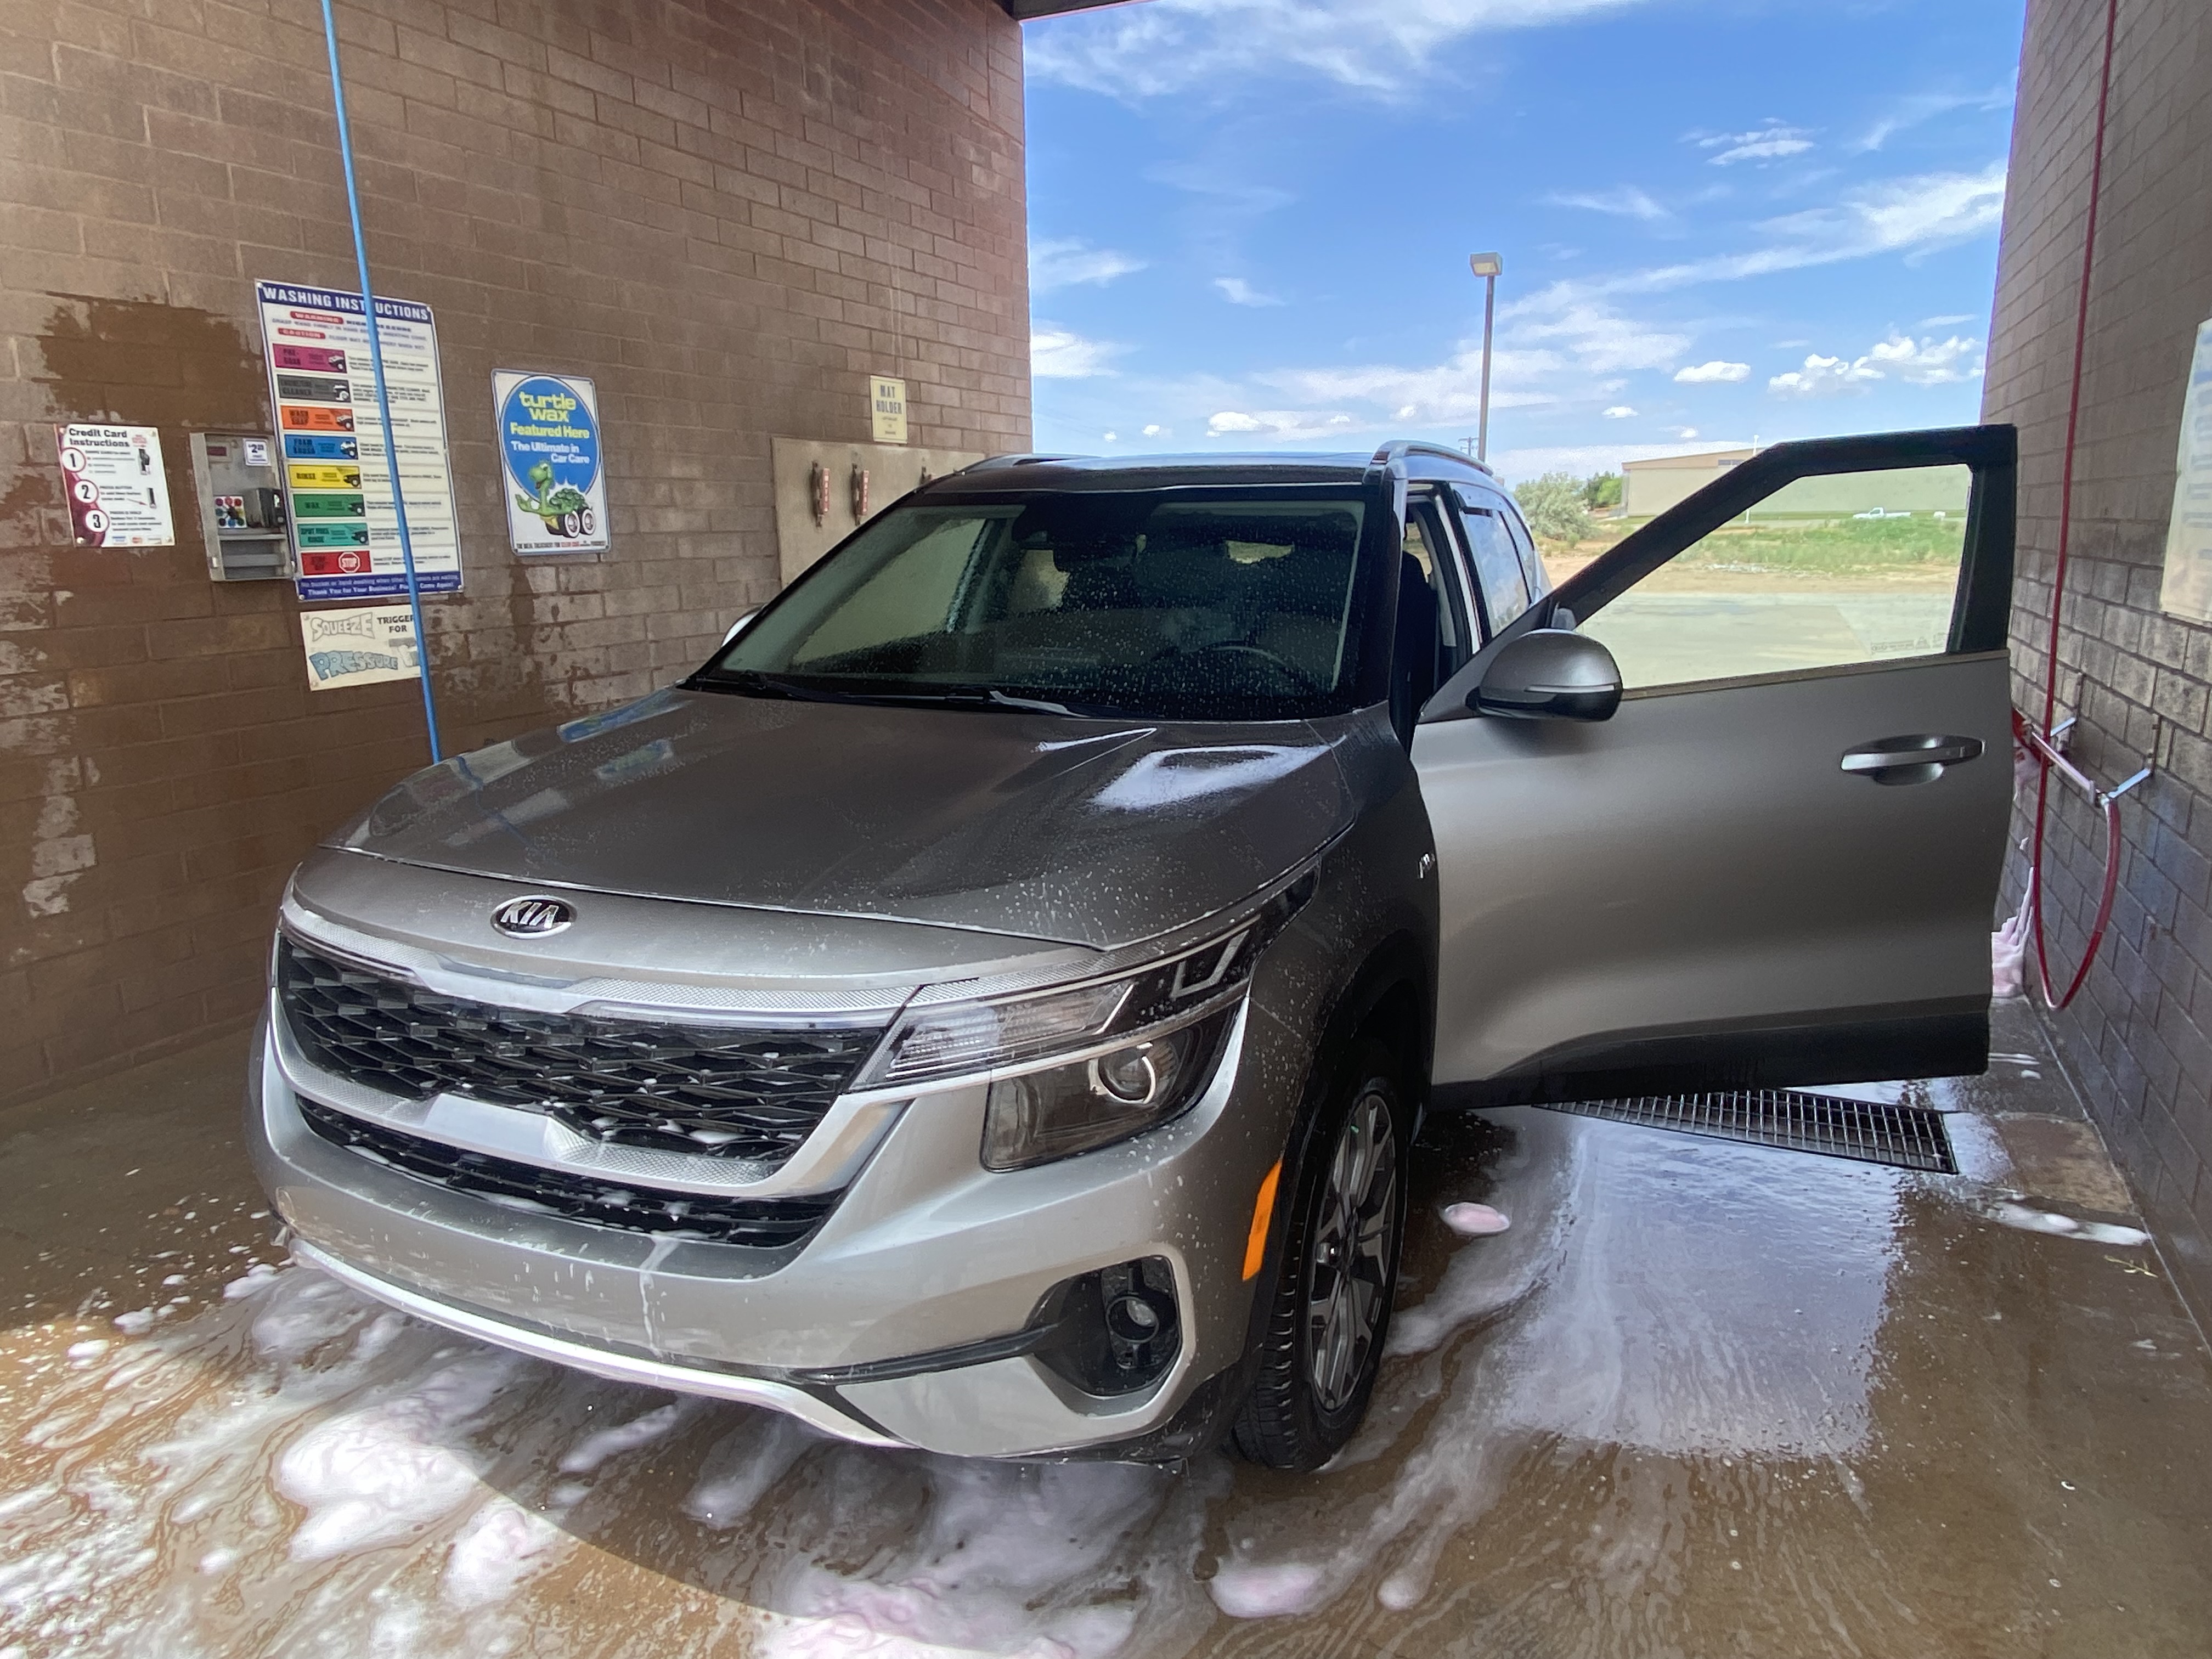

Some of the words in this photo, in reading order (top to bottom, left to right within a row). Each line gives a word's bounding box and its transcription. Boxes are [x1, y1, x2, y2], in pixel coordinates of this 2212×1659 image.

[263, 287, 332, 307] WASHING
[336, 297, 428, 320] INSTUCTIONS
[880, 385, 895, 398] MAT
[519, 391, 577, 411] turtle
[876, 399, 902, 415] HOLDER
[529, 408, 569, 422] wax
[69, 428, 101, 437] Credit
[104, 429, 127, 438] Card
[510, 422, 562, 438] Featured
[563, 426, 590, 439] Here
[69, 438, 129, 447] Instructions
[511, 440, 530, 452] The
[531, 441, 570, 453] Ultimate
[571, 443, 580, 453] in
[70, 453, 76, 467] 1
[551, 453, 568, 463] Car
[568, 454, 590, 464] Care
[81, 484, 91, 499] 2
[93, 514, 101, 528] 3
[341, 557, 358, 568] STOP
[311, 612, 376, 642] SQUEEZE
[389, 625, 407, 633] FOR
[309, 650, 398, 681] PRESSURE
[500, 901, 559, 929] KIA
